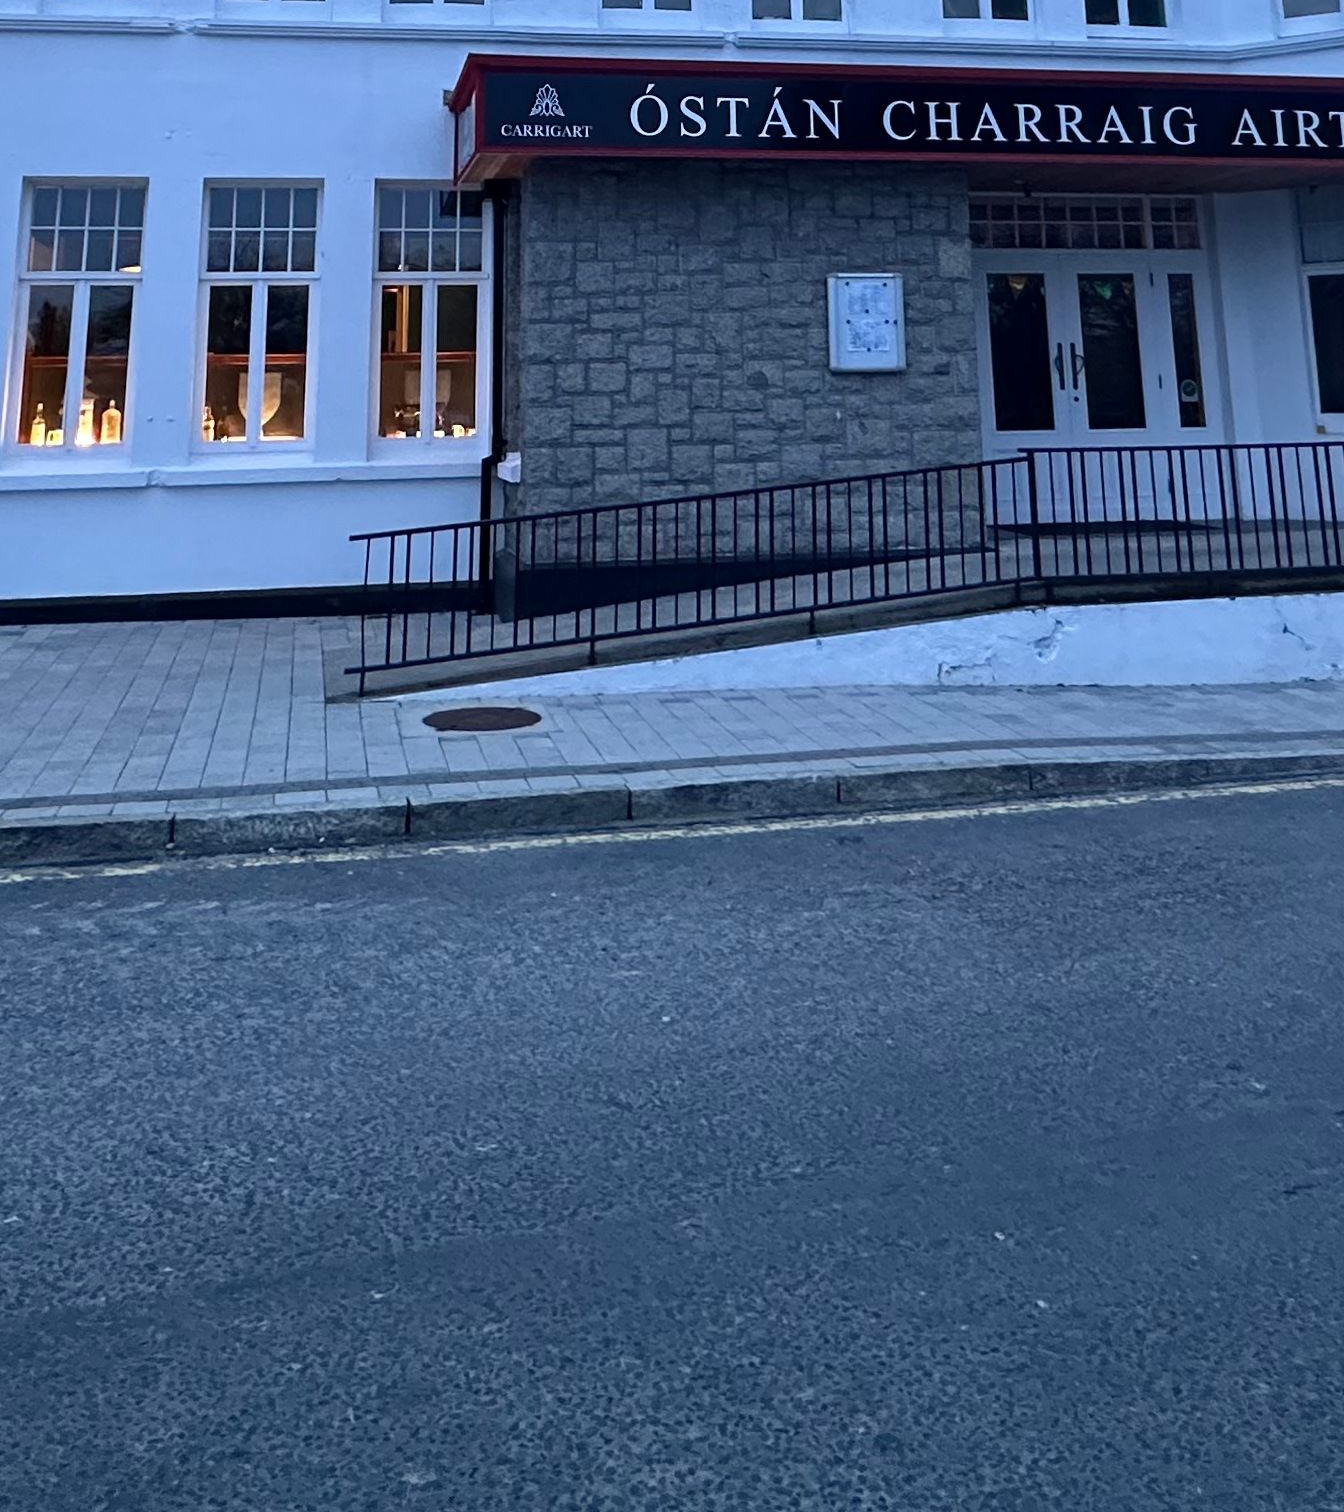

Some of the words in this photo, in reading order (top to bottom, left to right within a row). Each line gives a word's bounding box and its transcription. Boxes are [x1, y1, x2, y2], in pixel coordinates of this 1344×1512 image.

[501, 123, 592, 137] CARRIGART
[630, 84, 843, 139] ÓSTÁN
[882, 100, 1199, 146] CHARRAIG
